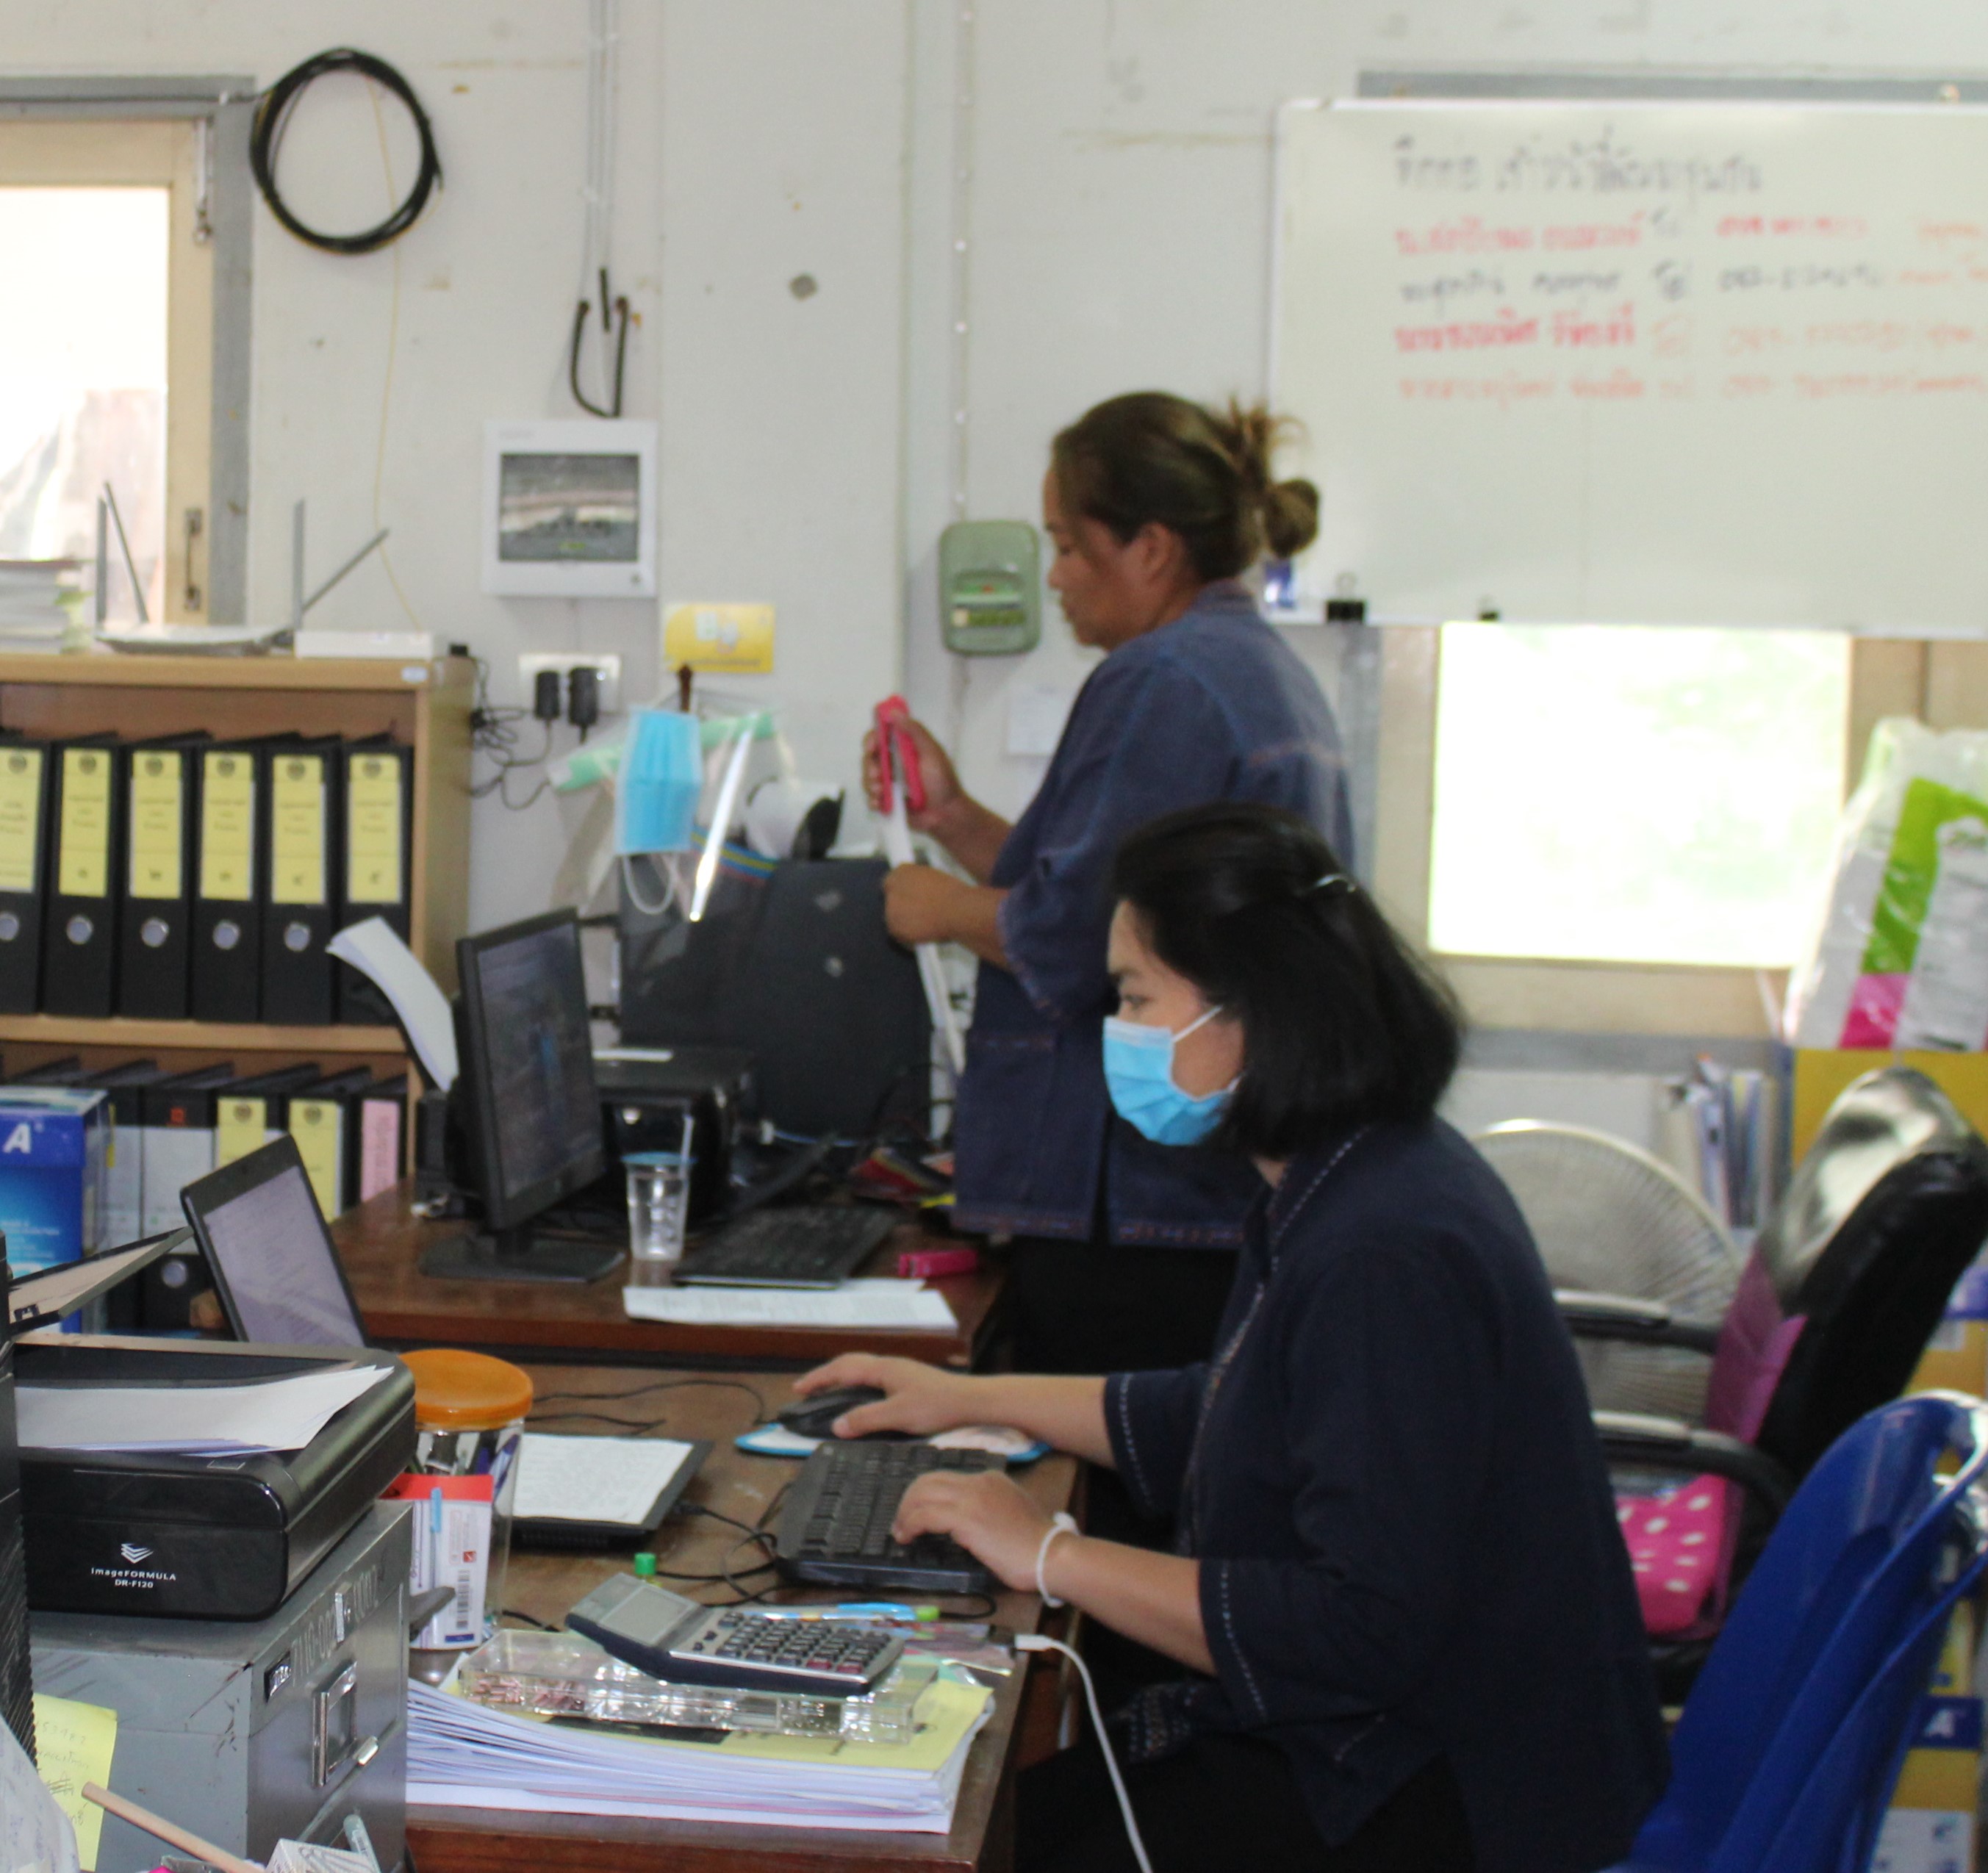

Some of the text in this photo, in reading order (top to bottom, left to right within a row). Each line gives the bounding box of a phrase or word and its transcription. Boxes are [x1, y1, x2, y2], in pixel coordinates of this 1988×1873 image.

[2, 1124, 31, 1154] A
[91, 1567, 176, 1581] imageFORMULA
[115, 1578, 154, 1589] DR-F120
